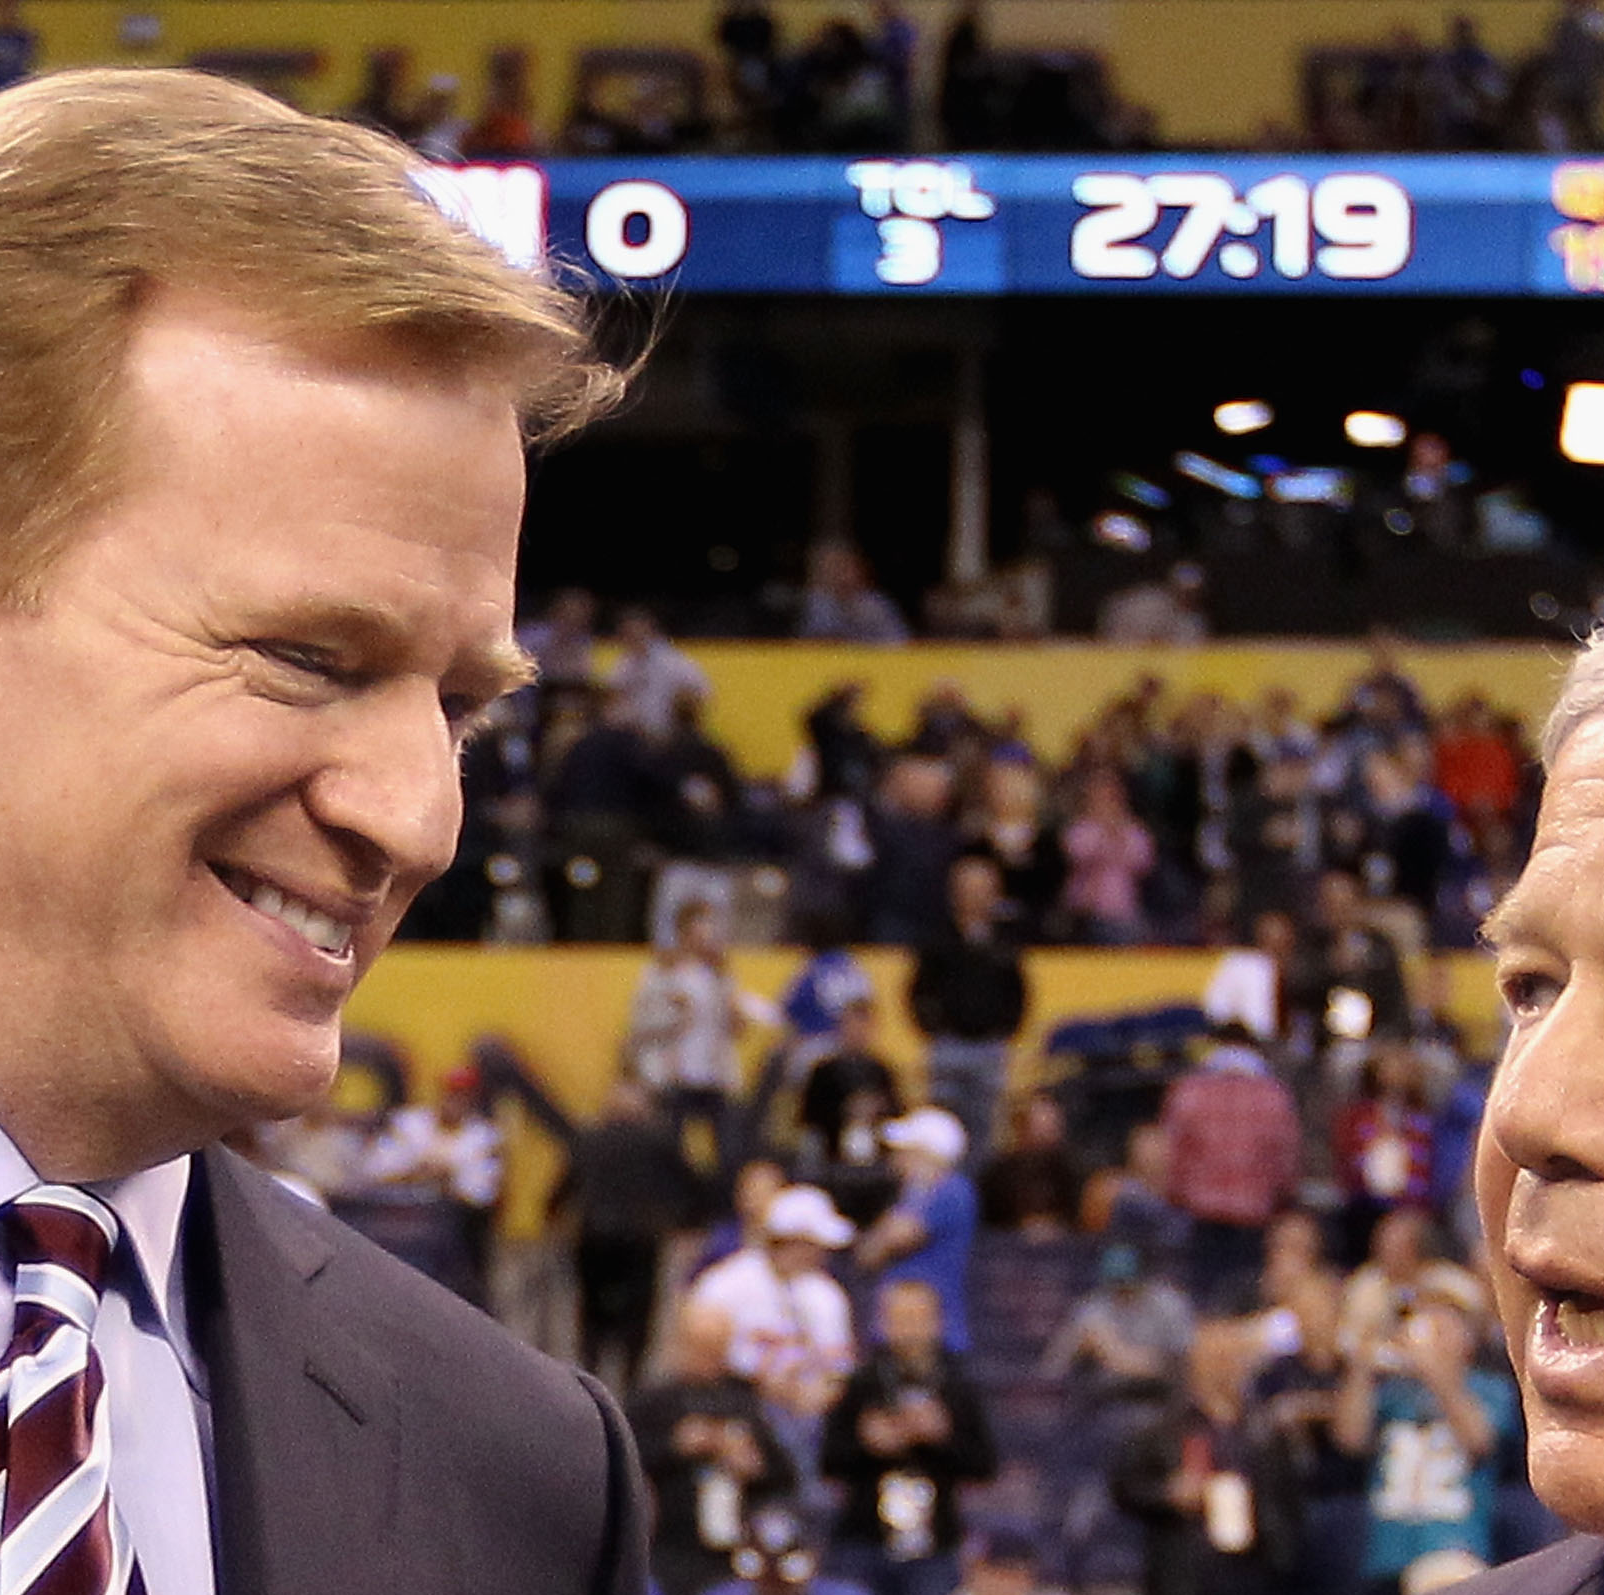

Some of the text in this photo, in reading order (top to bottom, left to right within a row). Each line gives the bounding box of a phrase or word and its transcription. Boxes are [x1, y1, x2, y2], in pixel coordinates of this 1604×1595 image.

[585, 178, 690, 279] 0
[875, 217, 942, 285] 3
[1069, 172, 1413, 280] 27:19
